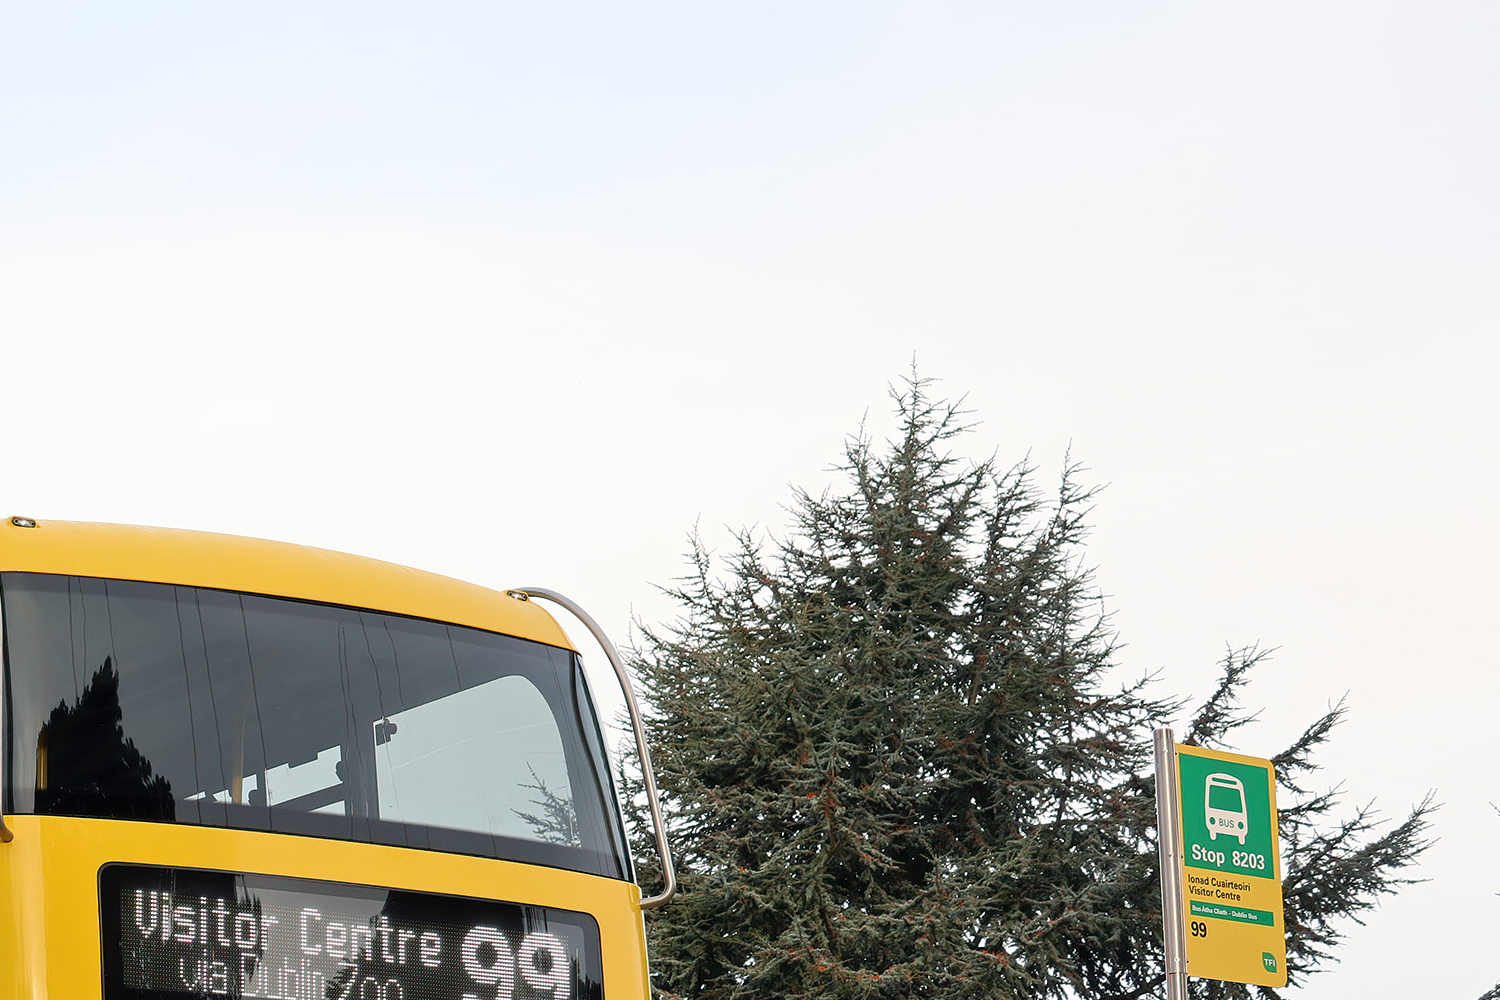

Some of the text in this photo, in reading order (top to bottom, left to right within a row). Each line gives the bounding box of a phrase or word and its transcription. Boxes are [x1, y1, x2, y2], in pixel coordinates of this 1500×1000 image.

[1218, 818, 1235, 829] BUS
[1192, 844, 1265, 870] Stop 8203
[1188, 874, 1209, 885] Ionad
[1188, 885, 1241, 901] Visitor Centre
[1192, 904, 1201, 912] Bus
[1232, 911, 1248, 919] Dublin
[135, 889, 442, 968] Visitor Centre
[1191, 921, 1207, 938] 99
[1264, 957, 1276, 967] TFI
[179, 949, 228, 994] via
